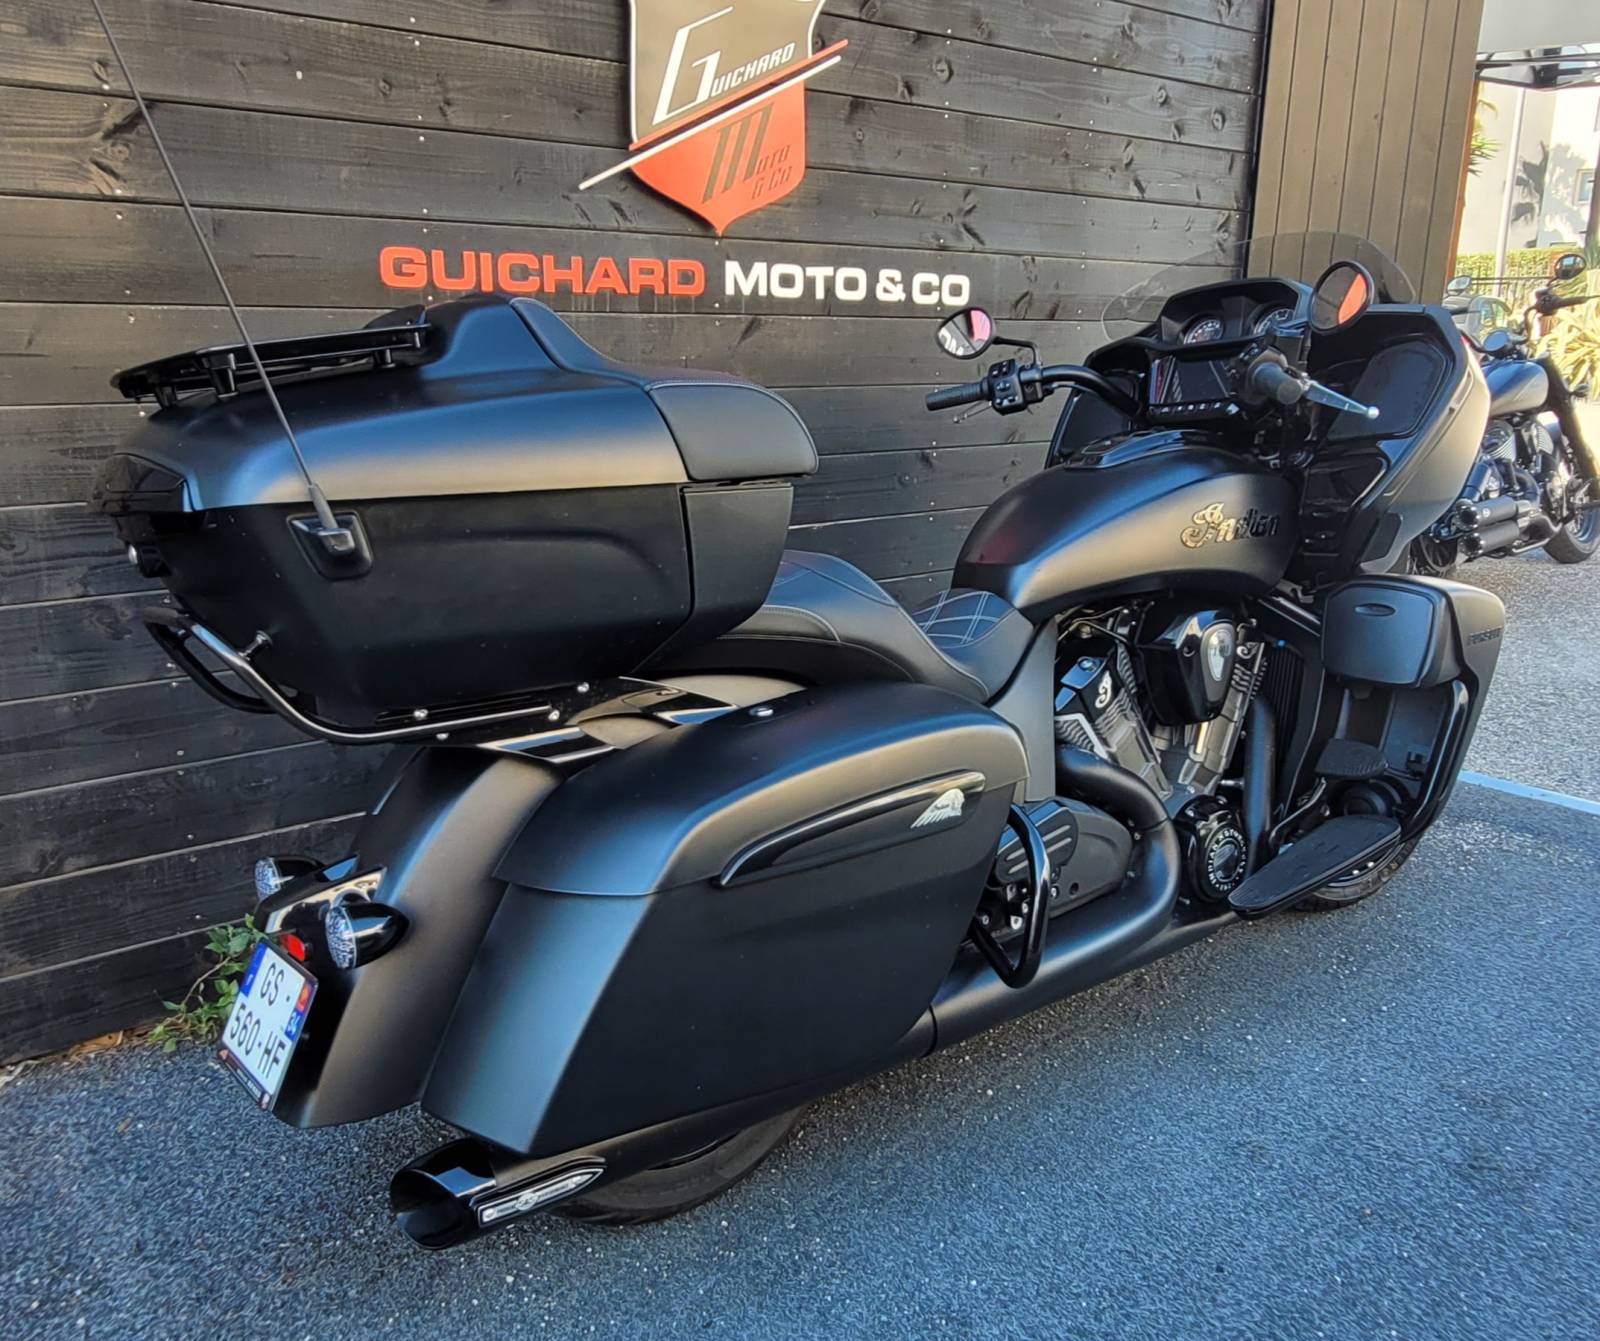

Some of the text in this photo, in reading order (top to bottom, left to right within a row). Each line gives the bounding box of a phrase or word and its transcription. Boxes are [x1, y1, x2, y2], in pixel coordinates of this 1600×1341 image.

[652, 6, 796, 125] GUICHARD
[379, 246, 706, 296] GUICHARD
[724, 261, 867, 301] MOTO
